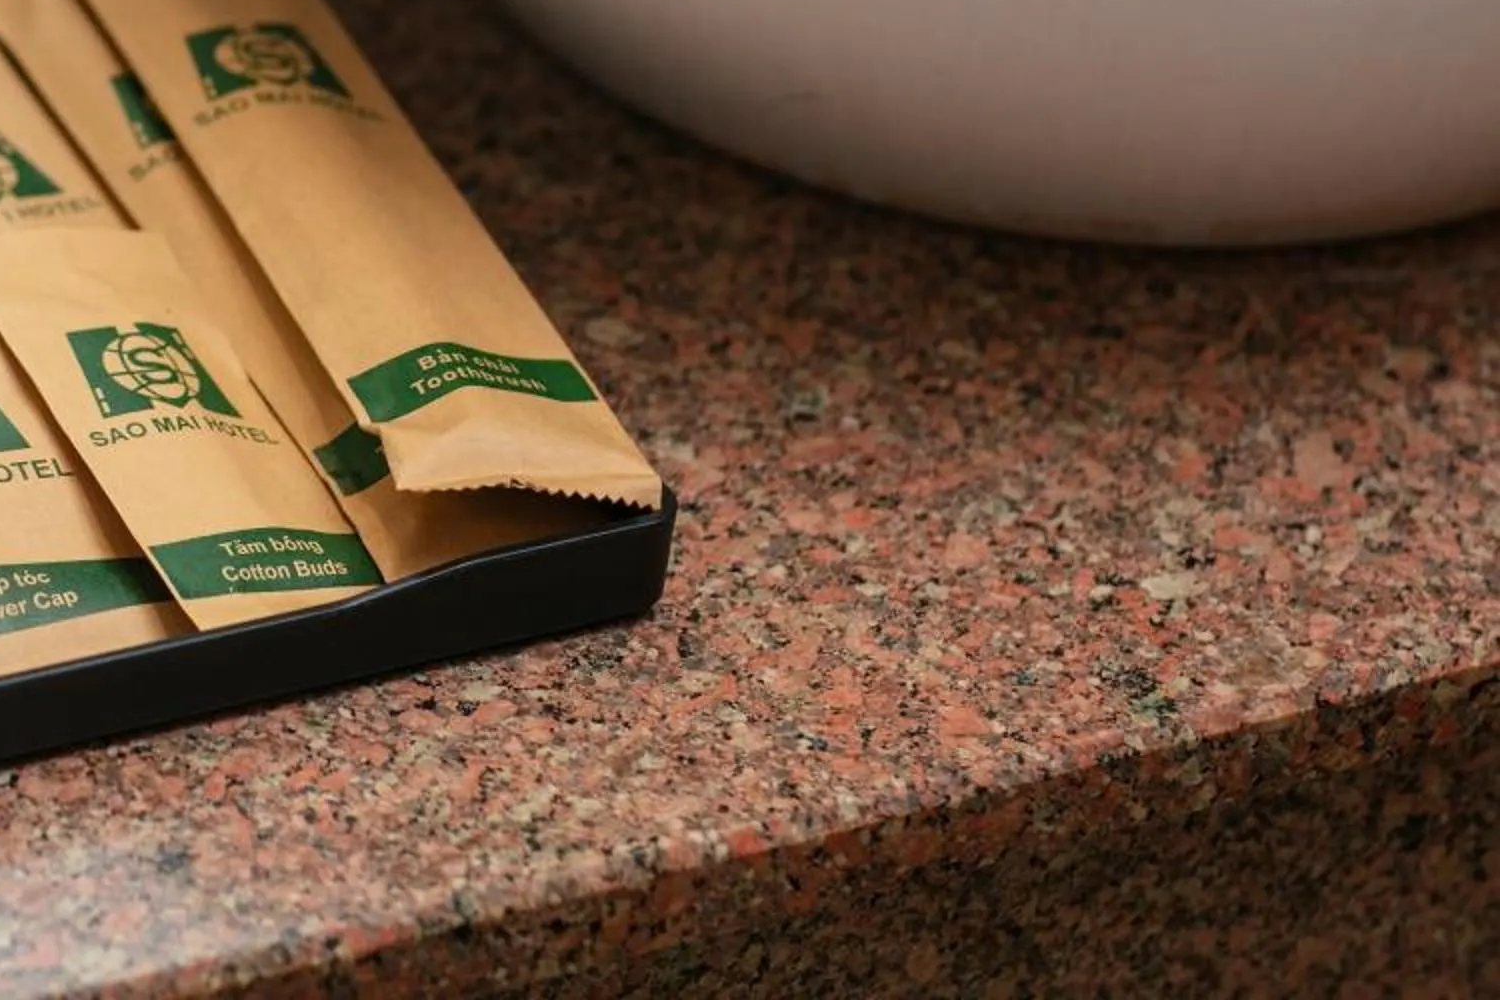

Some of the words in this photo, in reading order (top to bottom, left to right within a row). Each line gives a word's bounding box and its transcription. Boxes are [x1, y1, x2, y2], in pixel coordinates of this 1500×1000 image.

[409, 366, 547, 395] Toothbrush
[89, 422, 148, 447] SAO
[151, 415, 202, 433] MAI
[203, 416, 280, 445] HOTEL
[221, 563, 291, 582] Cotton
[293, 559, 349, 577] Buds
[33, 590, 79, 609] Cap
